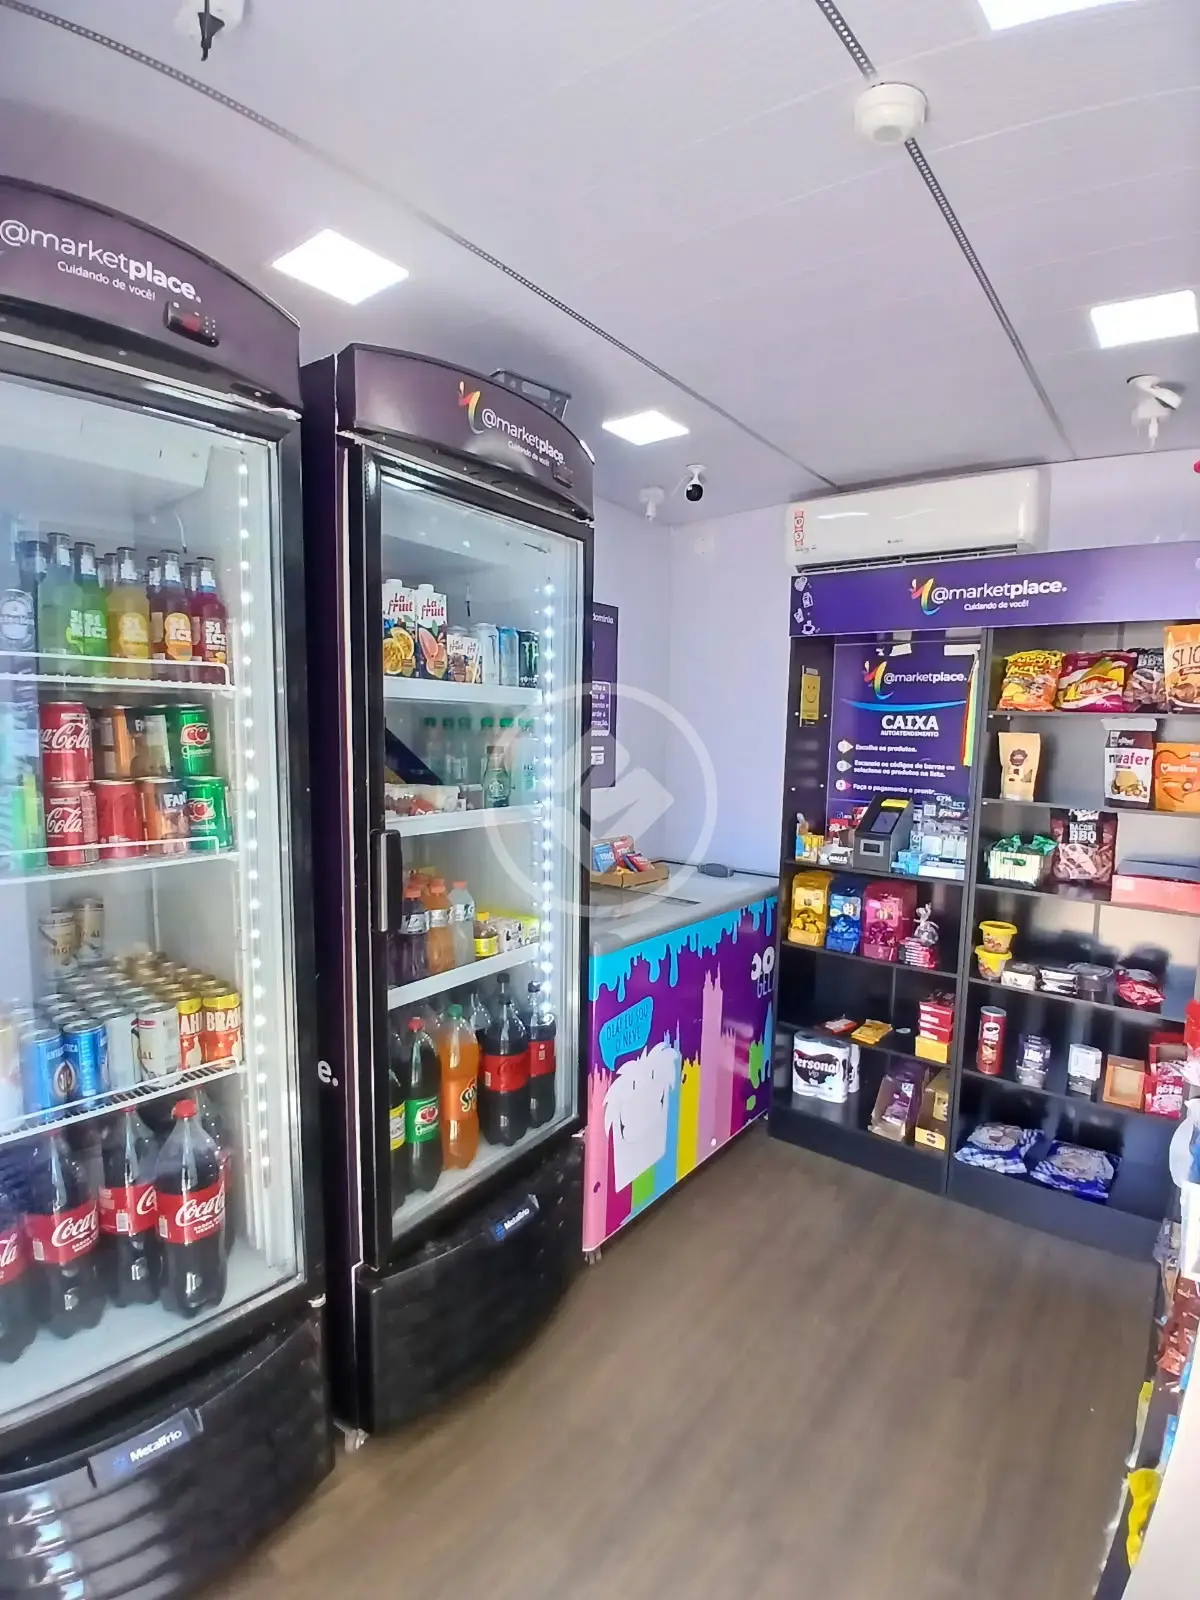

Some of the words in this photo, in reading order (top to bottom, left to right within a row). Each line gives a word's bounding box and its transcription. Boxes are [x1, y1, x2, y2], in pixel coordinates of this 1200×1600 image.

[0, 219, 202, 304] @marketplace.
[57, 260, 110, 286] Cuidando
[112, 277, 127, 291] de
[128, 282, 156, 302] você!
[481, 407, 566, 465] @marketplace.
[394, 592, 405, 603] La
[931, 577, 1067, 605] @marketplace.
[388, 598, 413, 615] fruit
[426, 598, 437, 608] La
[963, 601, 997, 612] Cuidando
[998, 600, 1009, 609] de
[1009, 597, 1029, 609] você!
[421, 604, 445, 620] fruit
[883, 671, 967, 684] @marketplace.
[881, 715, 939, 731] CAIXA
[1069, 831, 1097, 843] BBQ
[794, 1051, 839, 1074] Personal
[129, 1429, 183, 1463] Metalfrio
